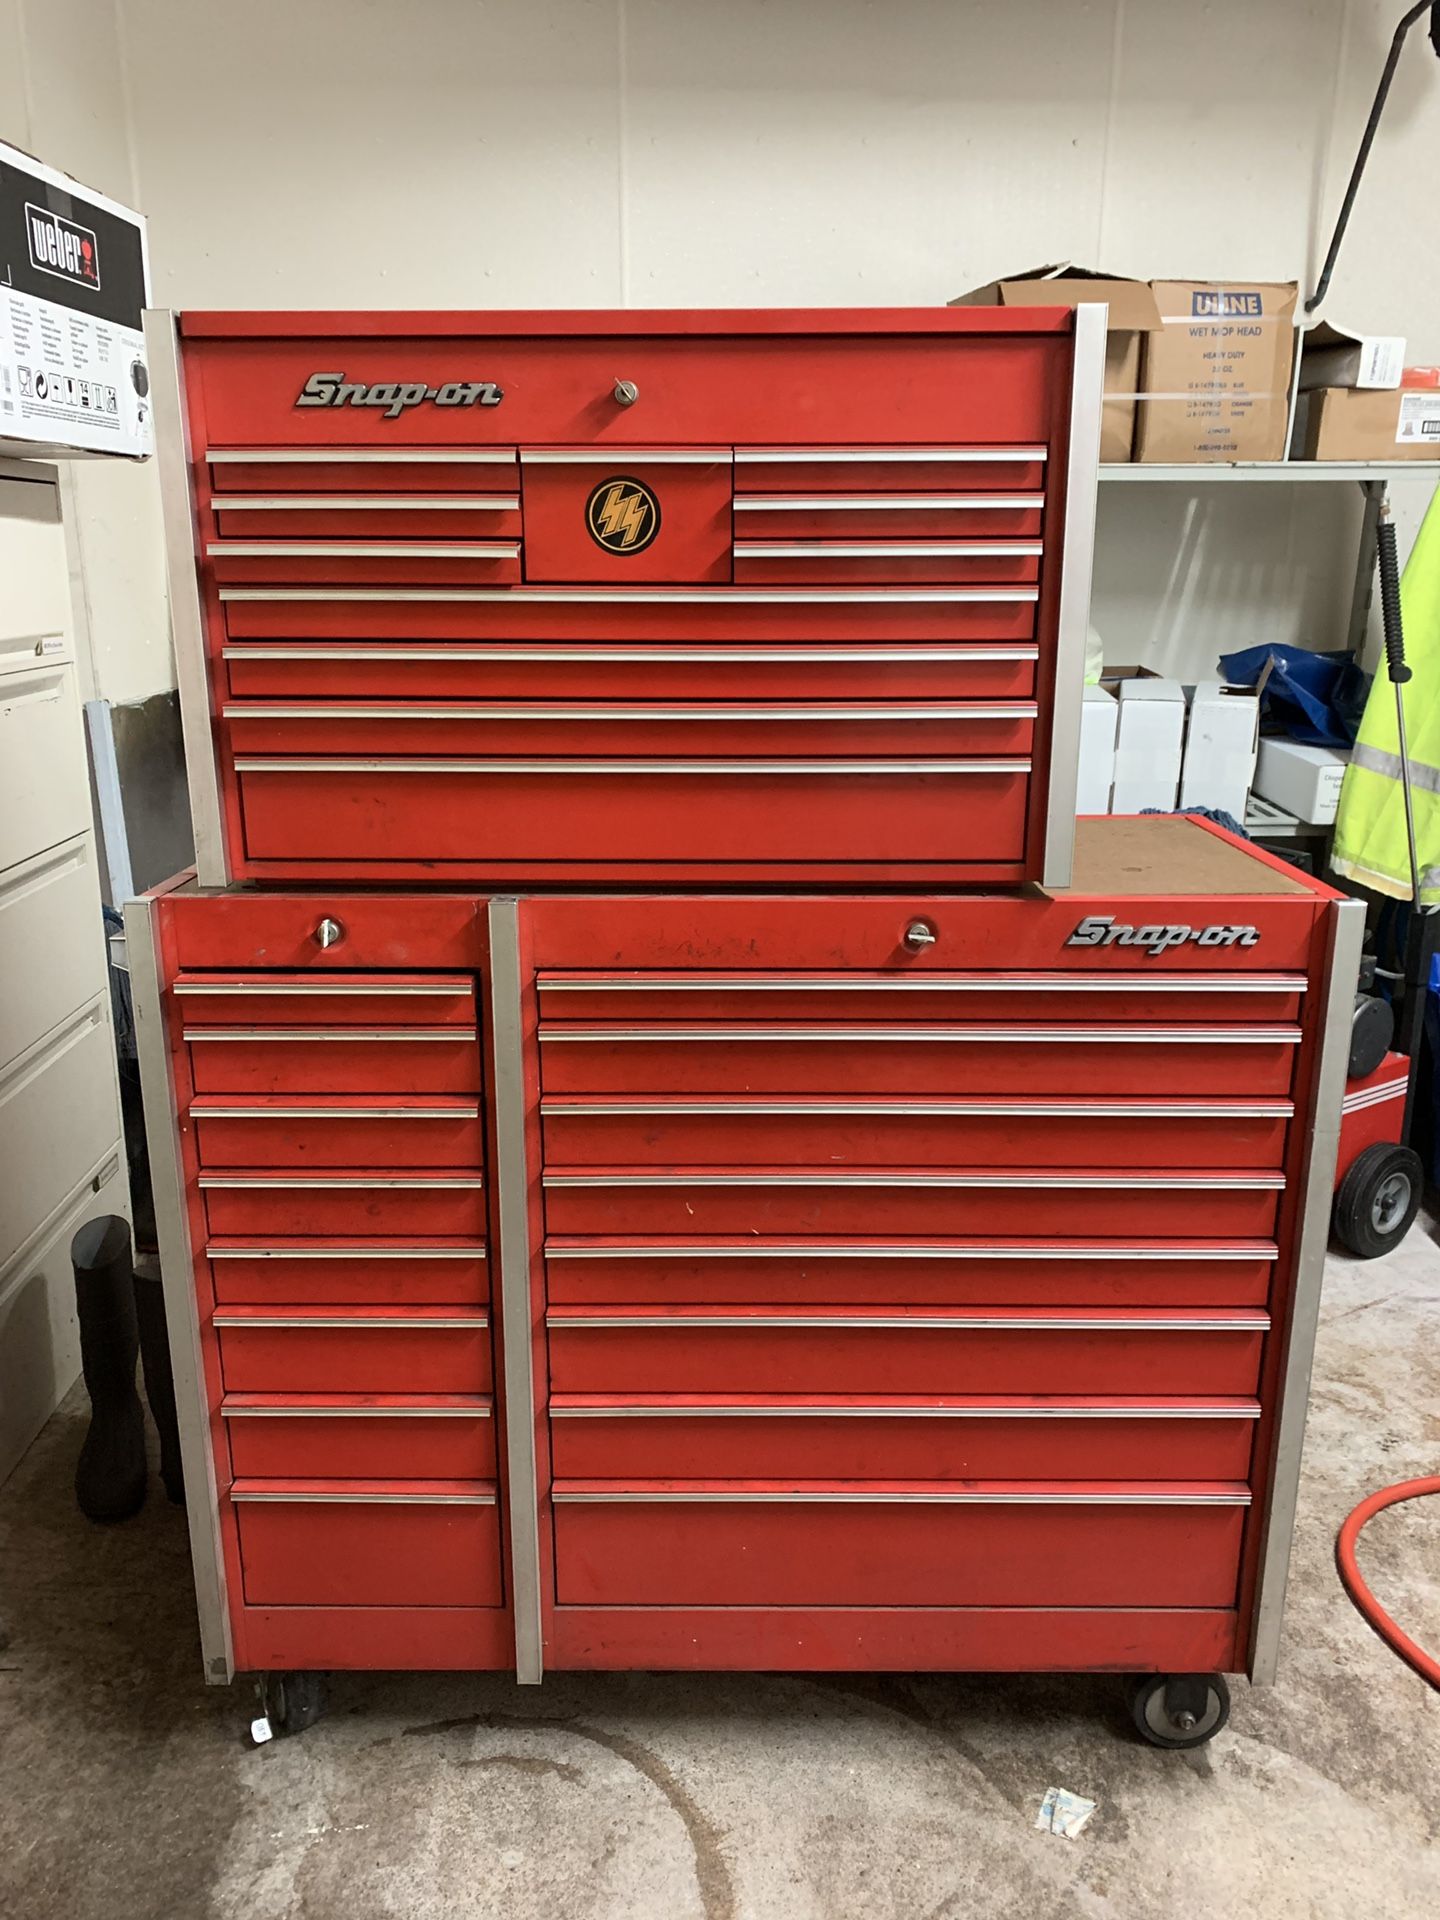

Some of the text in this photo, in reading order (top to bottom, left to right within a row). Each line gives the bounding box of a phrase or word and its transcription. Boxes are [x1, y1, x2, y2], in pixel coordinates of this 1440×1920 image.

[31, 216, 82, 274] weber
[1196, 295, 1259, 315] ULINE
[1189, 326, 1262, 337] WET MOP HEAD
[296, 371, 502, 418] Snap-on
[1067, 914, 1261, 955] Snap-on
